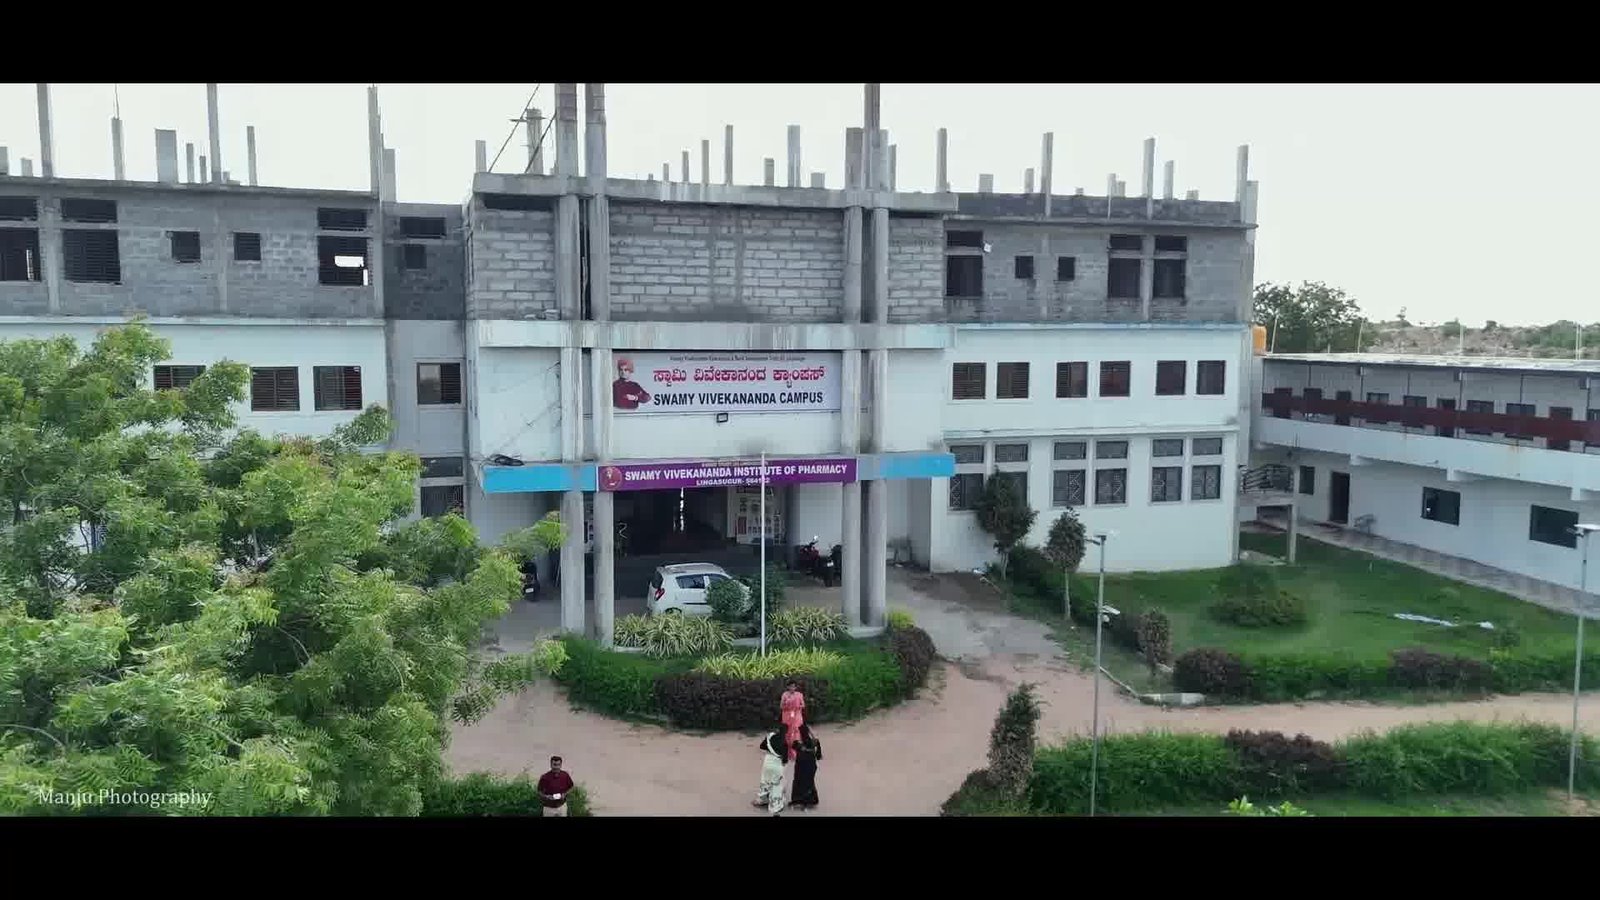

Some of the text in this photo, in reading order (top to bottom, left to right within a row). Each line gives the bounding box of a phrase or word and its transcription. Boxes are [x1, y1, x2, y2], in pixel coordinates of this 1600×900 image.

[653, 368, 687, 387] ಸ್ವಾಮಿ
[694, 366, 766, 381] ವಿವೇಕಾನಂದ
[653, 391, 823, 406] SWAMY VIVEKANANDA CAMPUS
[625, 464, 848, 481] SWAMY VIVEKANANDA INSTITUTE OF PHARMACY
